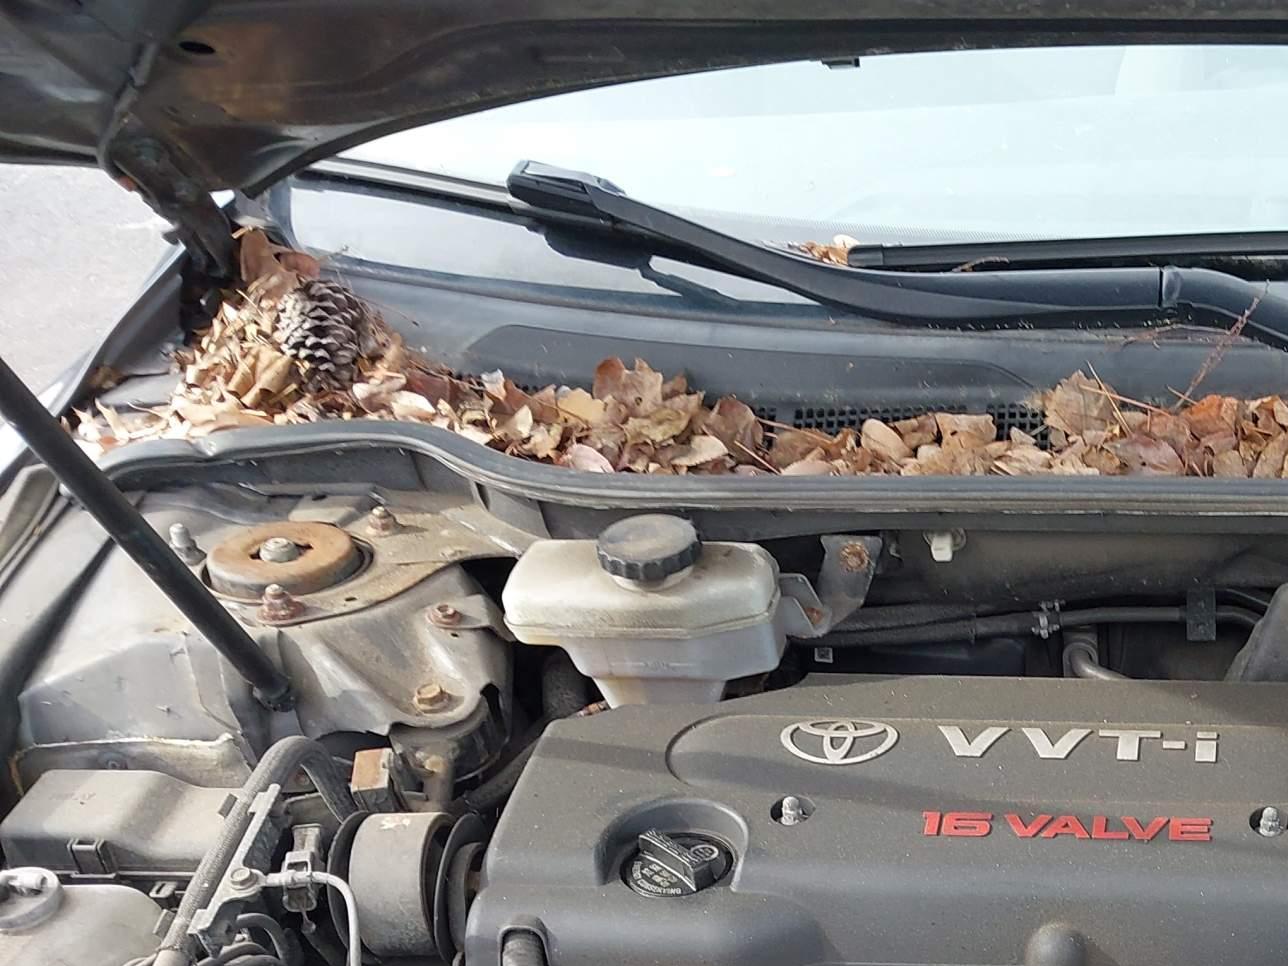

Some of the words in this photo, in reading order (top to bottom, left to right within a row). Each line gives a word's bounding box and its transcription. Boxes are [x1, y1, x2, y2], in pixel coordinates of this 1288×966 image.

[938, 726, 1219, 762] VVT-i
[922, 811, 993, 837] 16
[1004, 814, 1213, 841] VALVE
